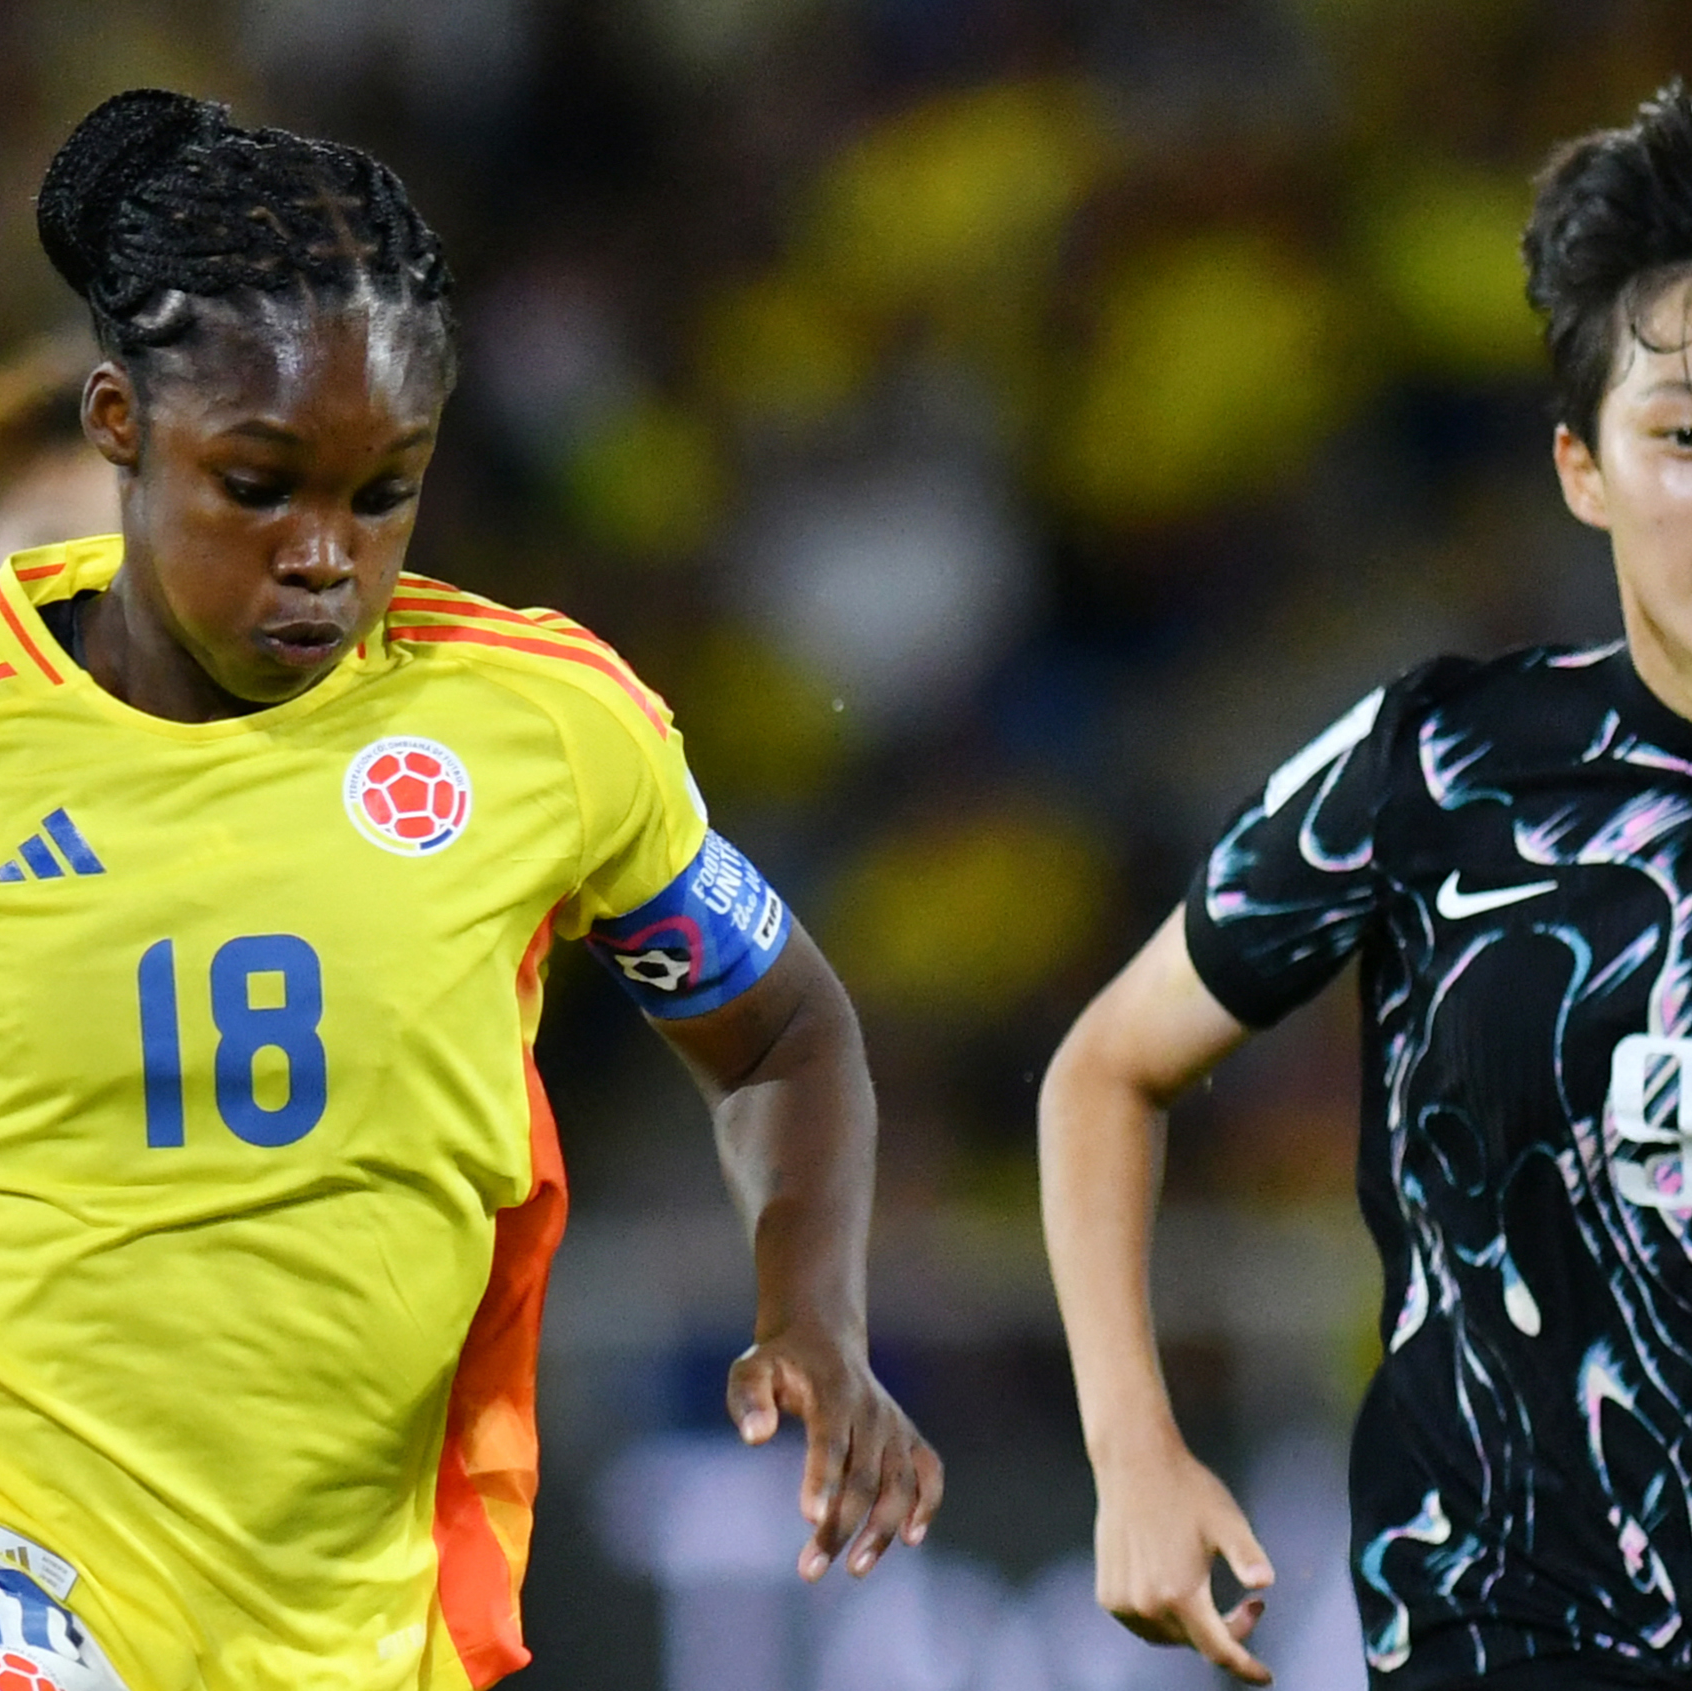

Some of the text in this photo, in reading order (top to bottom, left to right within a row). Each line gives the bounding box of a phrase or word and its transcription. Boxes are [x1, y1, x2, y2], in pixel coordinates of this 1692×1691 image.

[705, 835, 743, 915] UNITE
[761, 896, 778, 939] FIFA
[138, 933, 327, 1148] 18
